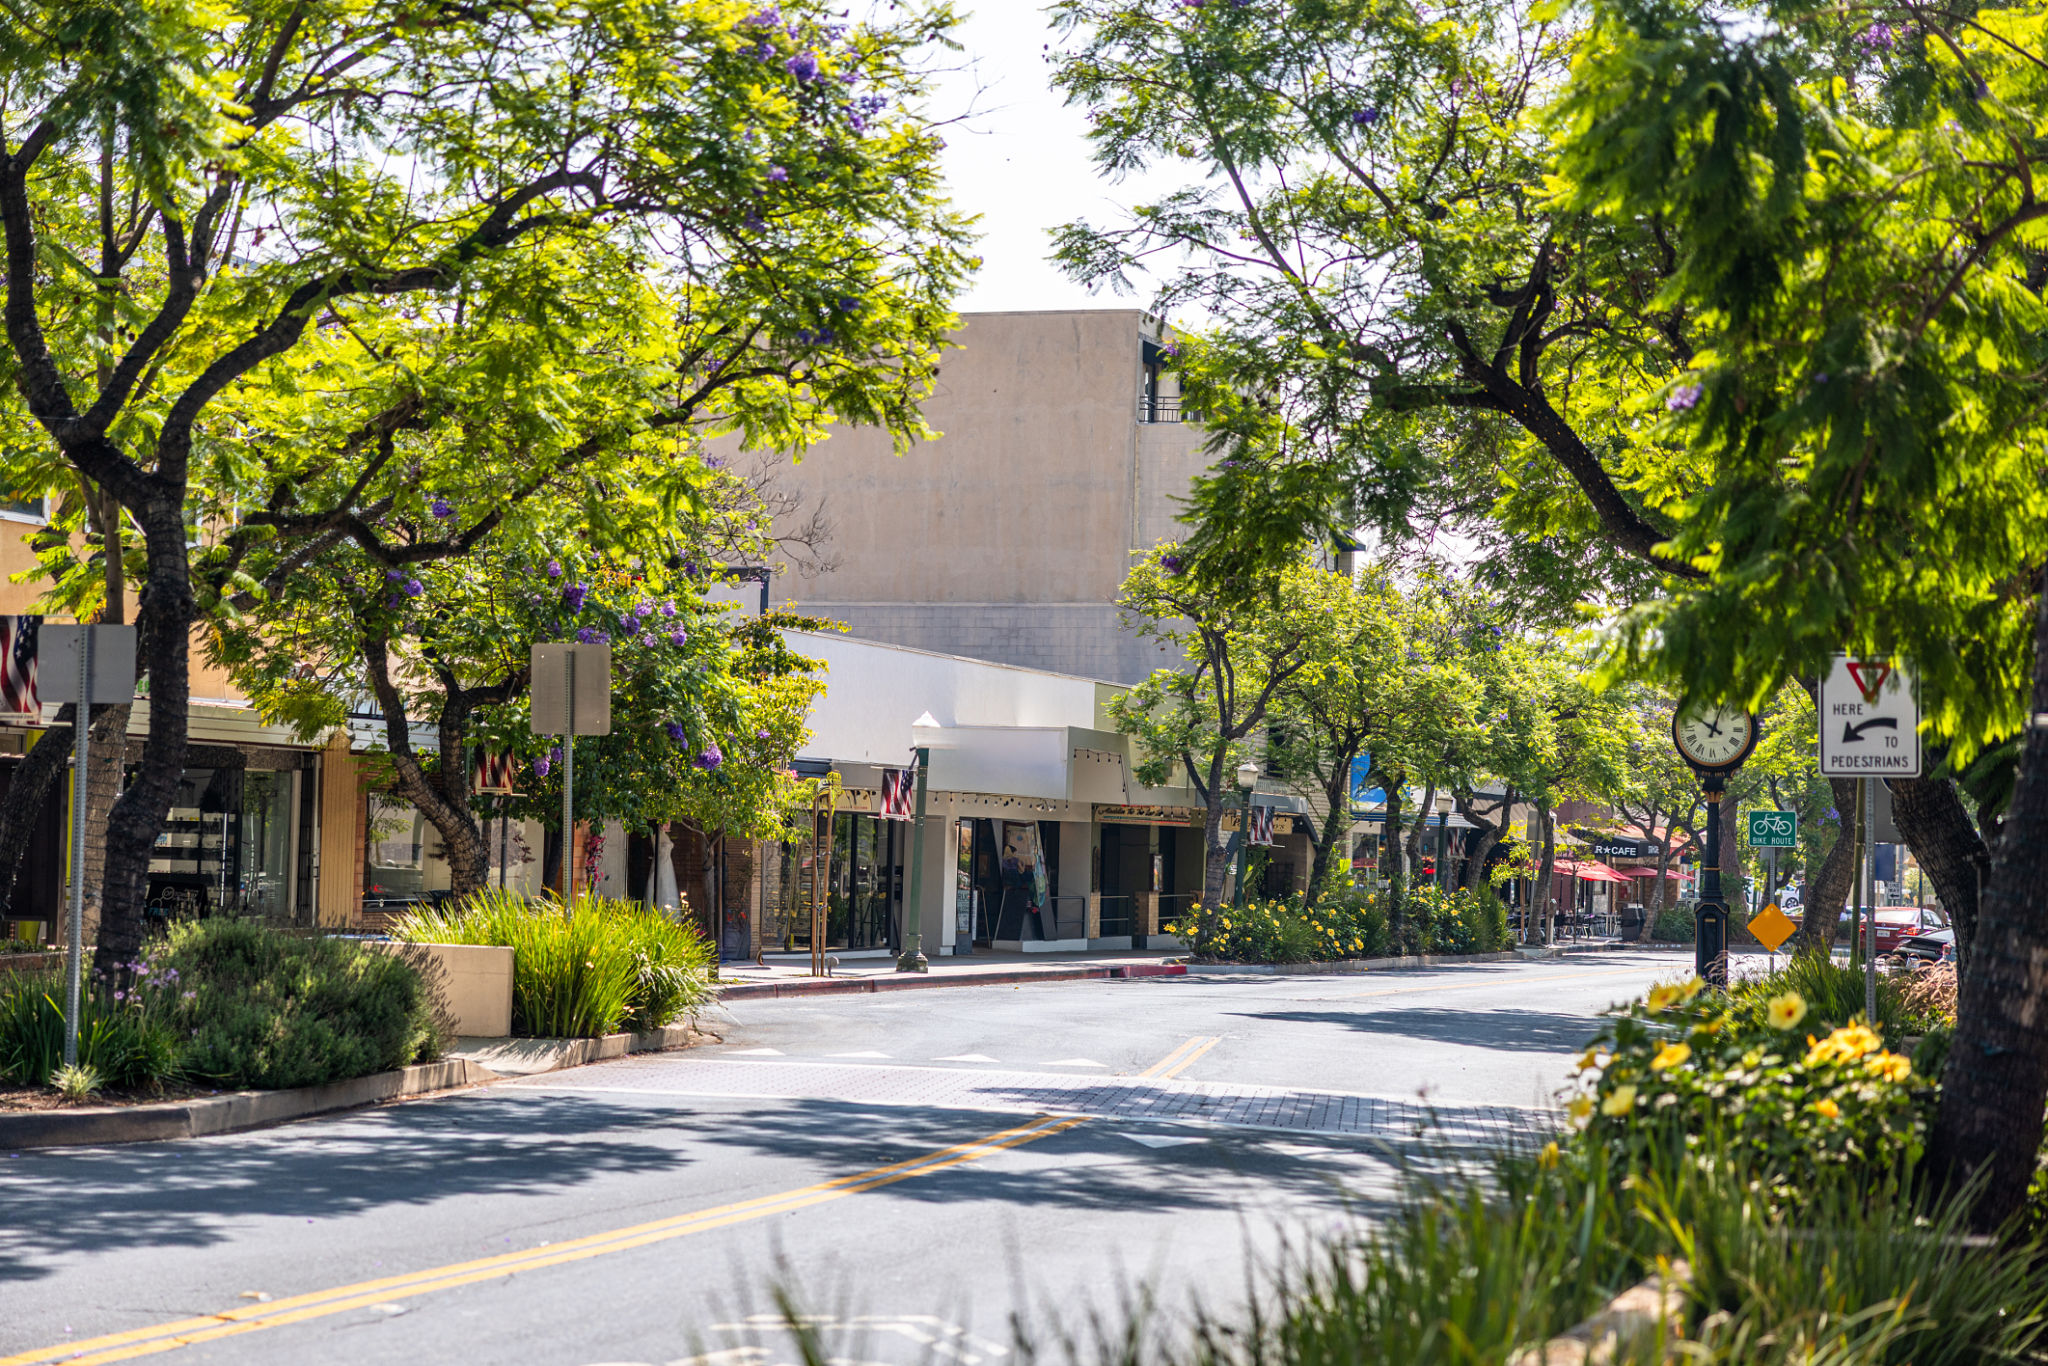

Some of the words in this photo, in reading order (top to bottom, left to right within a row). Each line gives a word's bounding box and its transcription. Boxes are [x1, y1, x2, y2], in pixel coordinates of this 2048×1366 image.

[1833, 703, 1863, 715] HERE
[1885, 736, 1898, 748] TO
[1831, 755, 1908, 768] PEDESTRIANS
[1771, 837, 1792, 845] ROUTE
[1611, 846, 1637, 856] CAFE
